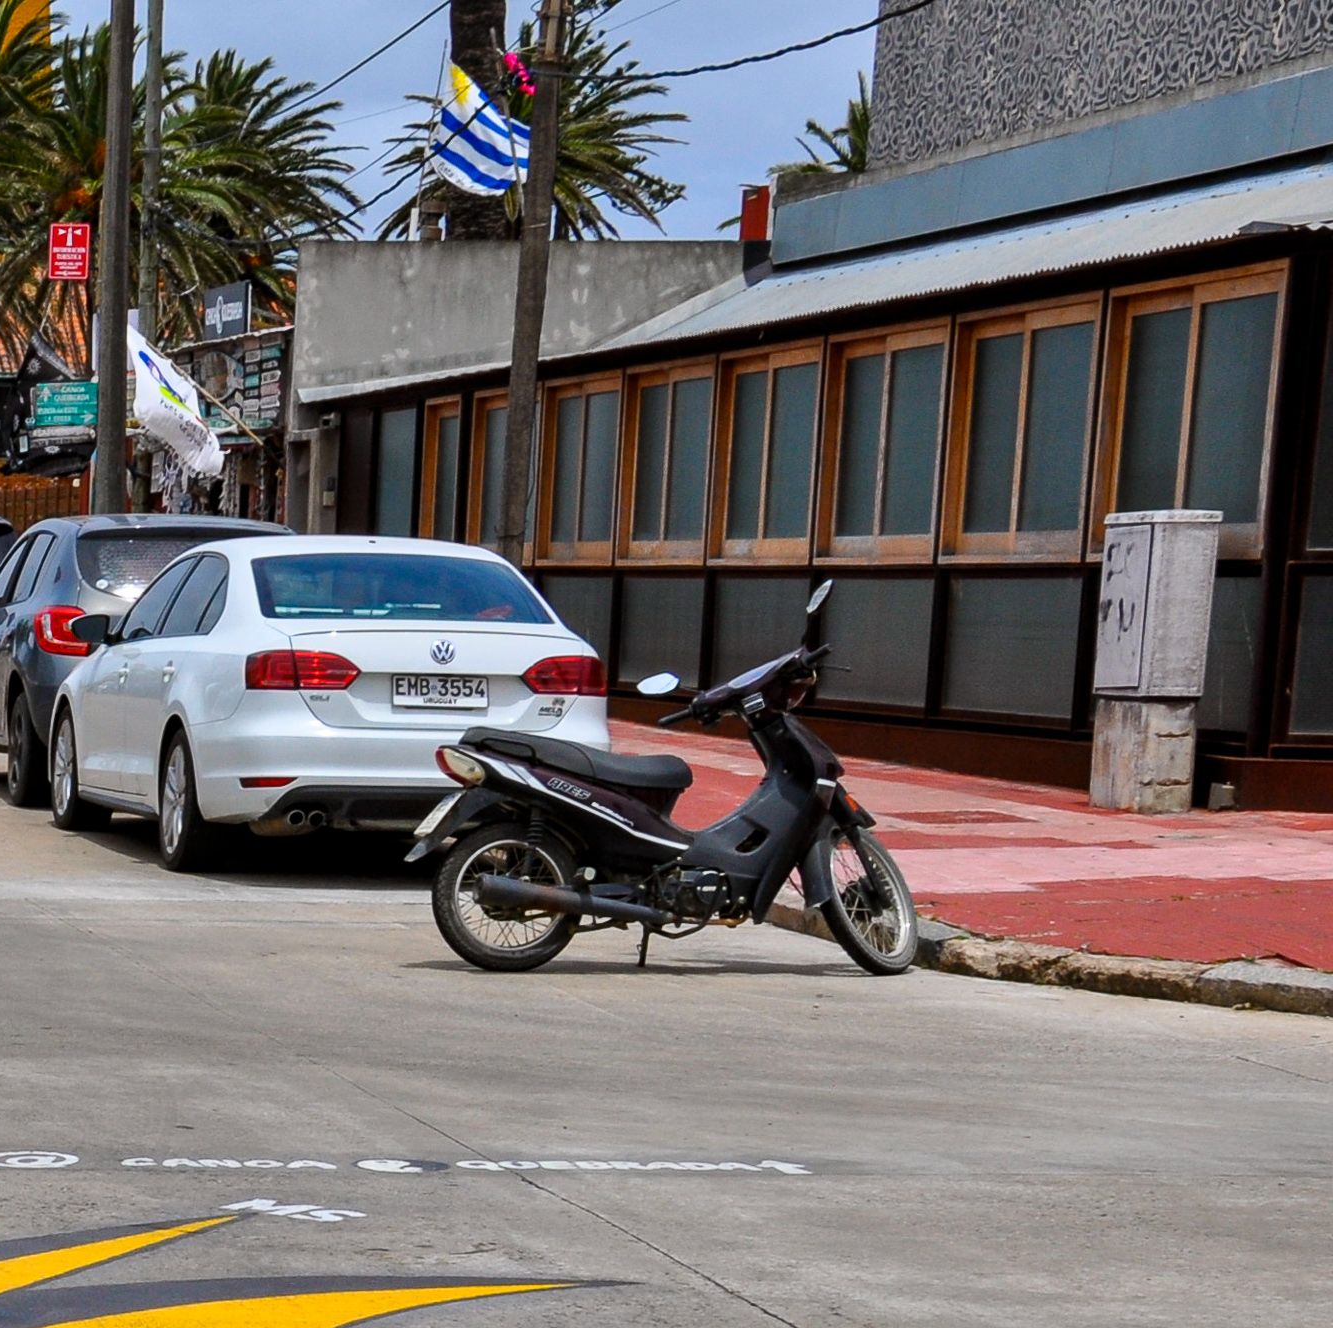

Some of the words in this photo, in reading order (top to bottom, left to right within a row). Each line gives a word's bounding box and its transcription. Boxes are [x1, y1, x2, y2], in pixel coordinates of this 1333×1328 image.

[395, 678, 430, 697] EMB
[437, 678, 486, 698] 3554
[423, 697, 458, 705] URUGUAY
[121, 1157, 337, 1169] CANOA
[455, 1159, 764, 1172] QUEBRADA
